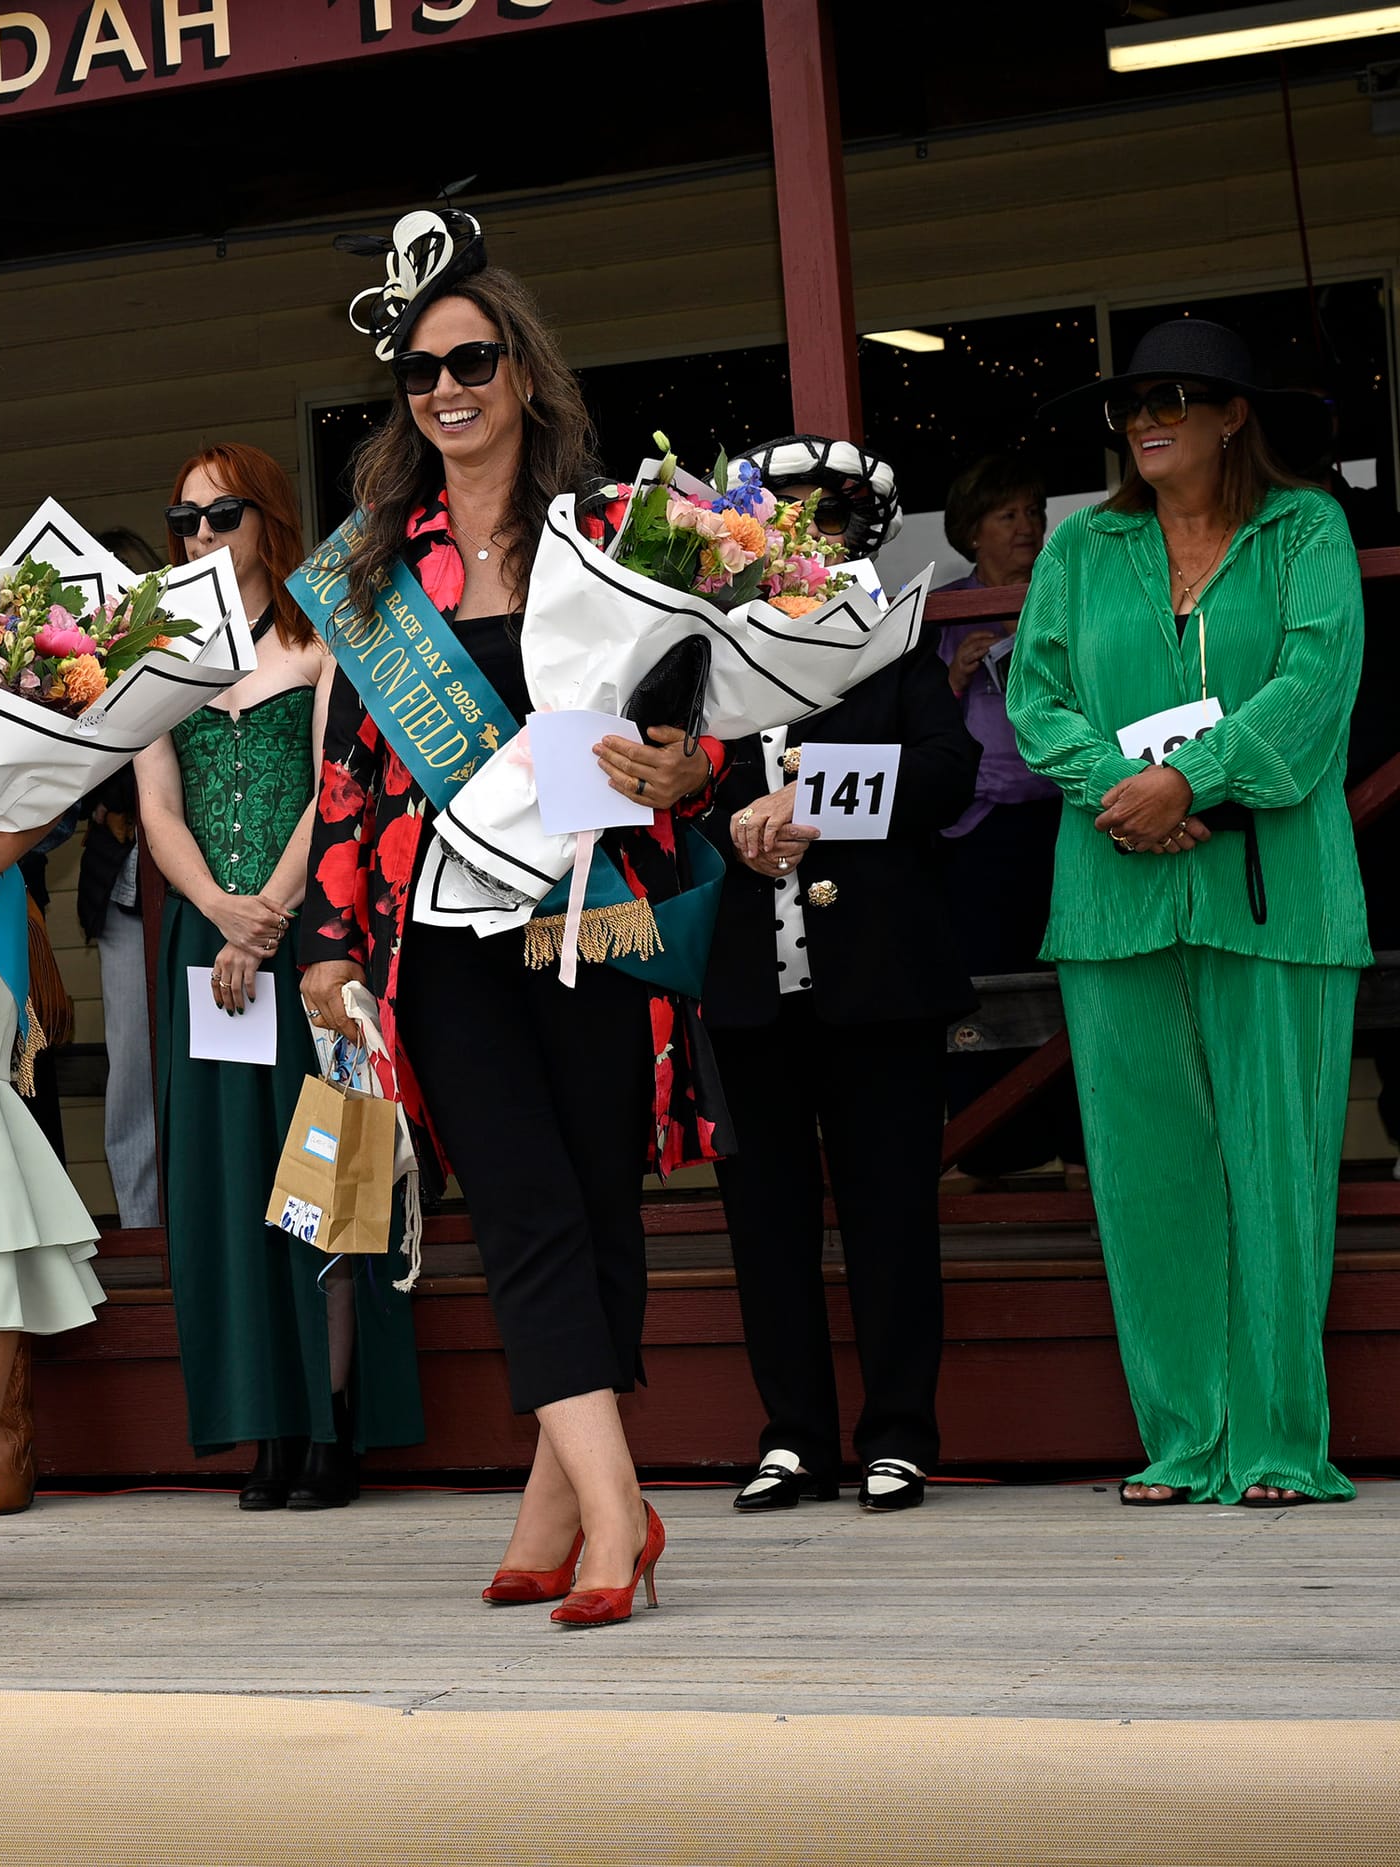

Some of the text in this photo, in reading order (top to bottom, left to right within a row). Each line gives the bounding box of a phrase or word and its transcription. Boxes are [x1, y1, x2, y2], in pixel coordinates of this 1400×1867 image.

[371, 647, 418, 699] ON
[385, 591, 423, 640] RACE
[415, 636, 452, 679] DAY
[445, 681, 484, 724] 2025
[389, 680, 469, 768] FIELD
[804, 771, 885, 815] 141
